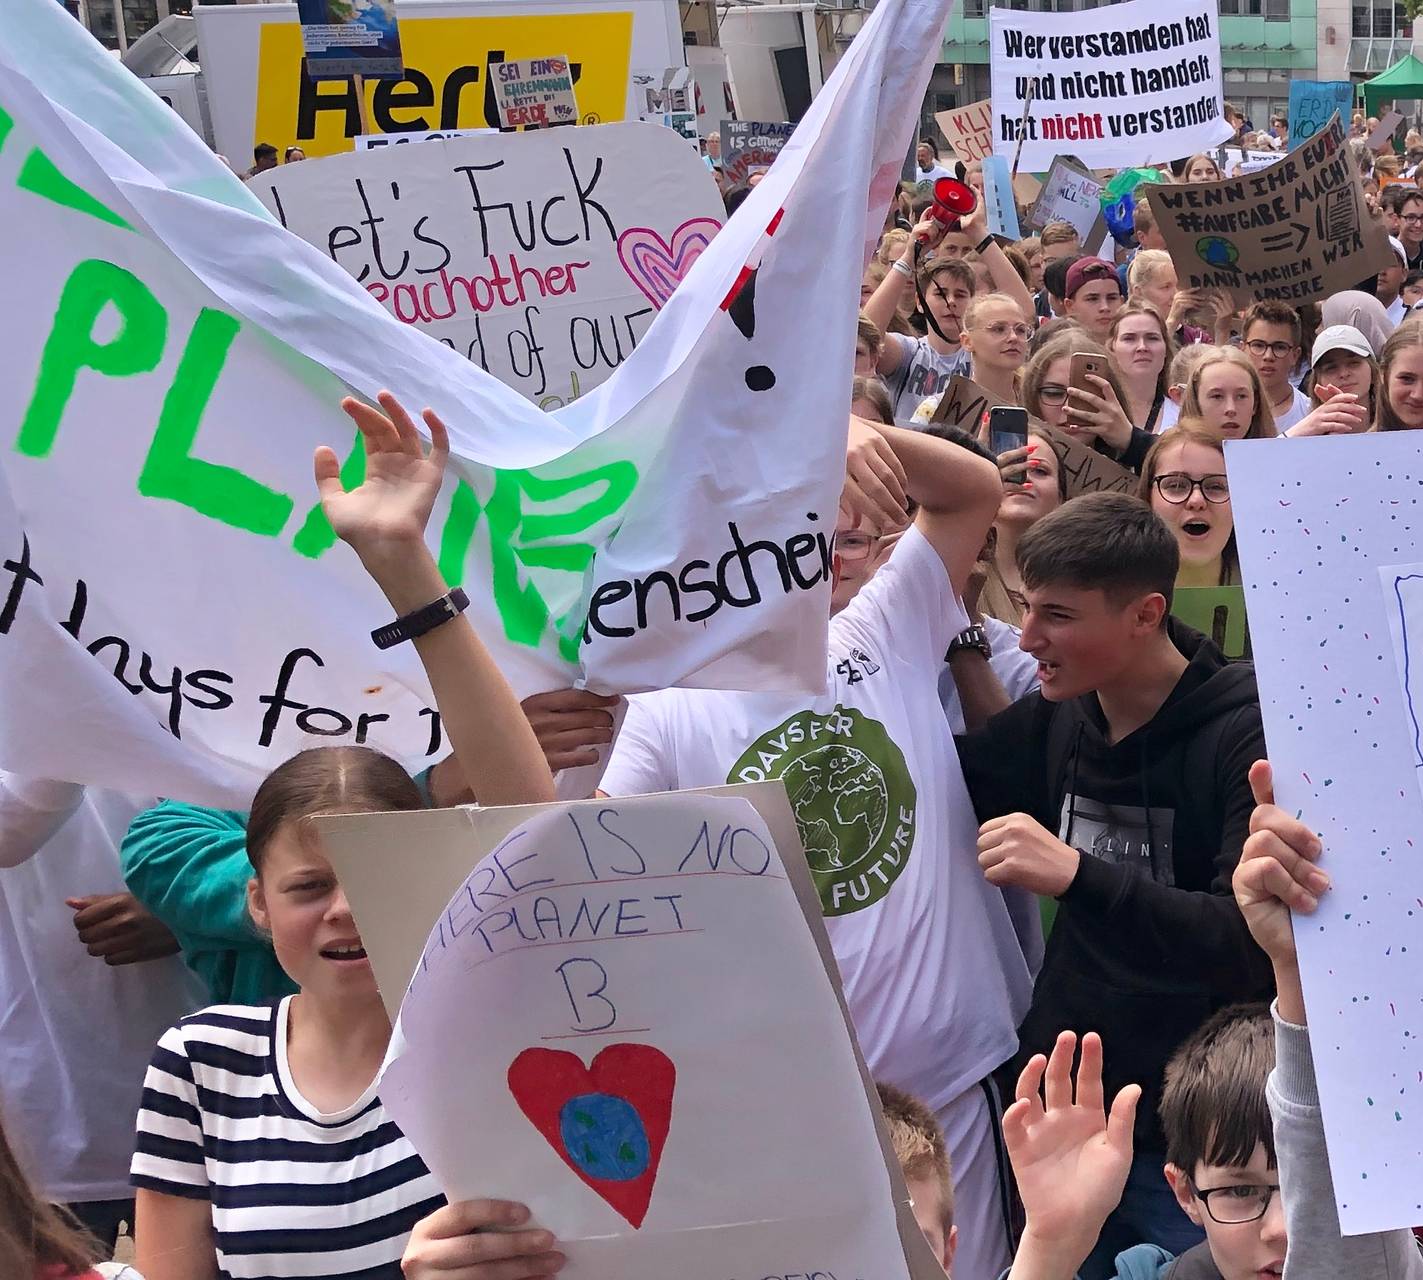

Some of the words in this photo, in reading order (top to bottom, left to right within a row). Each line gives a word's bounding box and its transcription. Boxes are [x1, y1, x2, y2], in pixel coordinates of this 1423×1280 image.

[1004, 29, 1045, 59] Wer
[1048, 23, 1184, 60] verstanden
[1186, 12, 1212, 43] hat
[499, 63, 520, 82] SEI
[1016, 73, 1056, 101] und
[1061, 71, 1128, 99] nicht
[728, 123, 748, 132] THE
[751, 122, 797, 136] PLANE
[730, 135, 746, 149] IS
[1001, 114, 1038, 141] hat
[1041, 112, 1104, 141] nicht
[1107, 95, 1220, 138] verstanden
[454, 147, 619, 258] Fuck
[1158, 183, 1245, 209] WENN
[1250, 162, 1300, 197] IHR
[1294, 150, 1350, 213] MACHT
[1190, 271, 1241, 289] DANN
[1246, 257, 1312, 286] MACHEN
[1322, 230, 1364, 265] WIR
[1254, 275, 1324, 302] UNSERE
[508, 306, 545, 396] of
[571, 308, 653, 370] our
[259, 648, 389, 747] for
[568, 808, 646, 880] IS
[678, 820, 770, 875] NO
[832, 805, 914, 909] FUTURE
[471, 894, 683, 952] PLANET
[554, 957, 616, 1033] B
